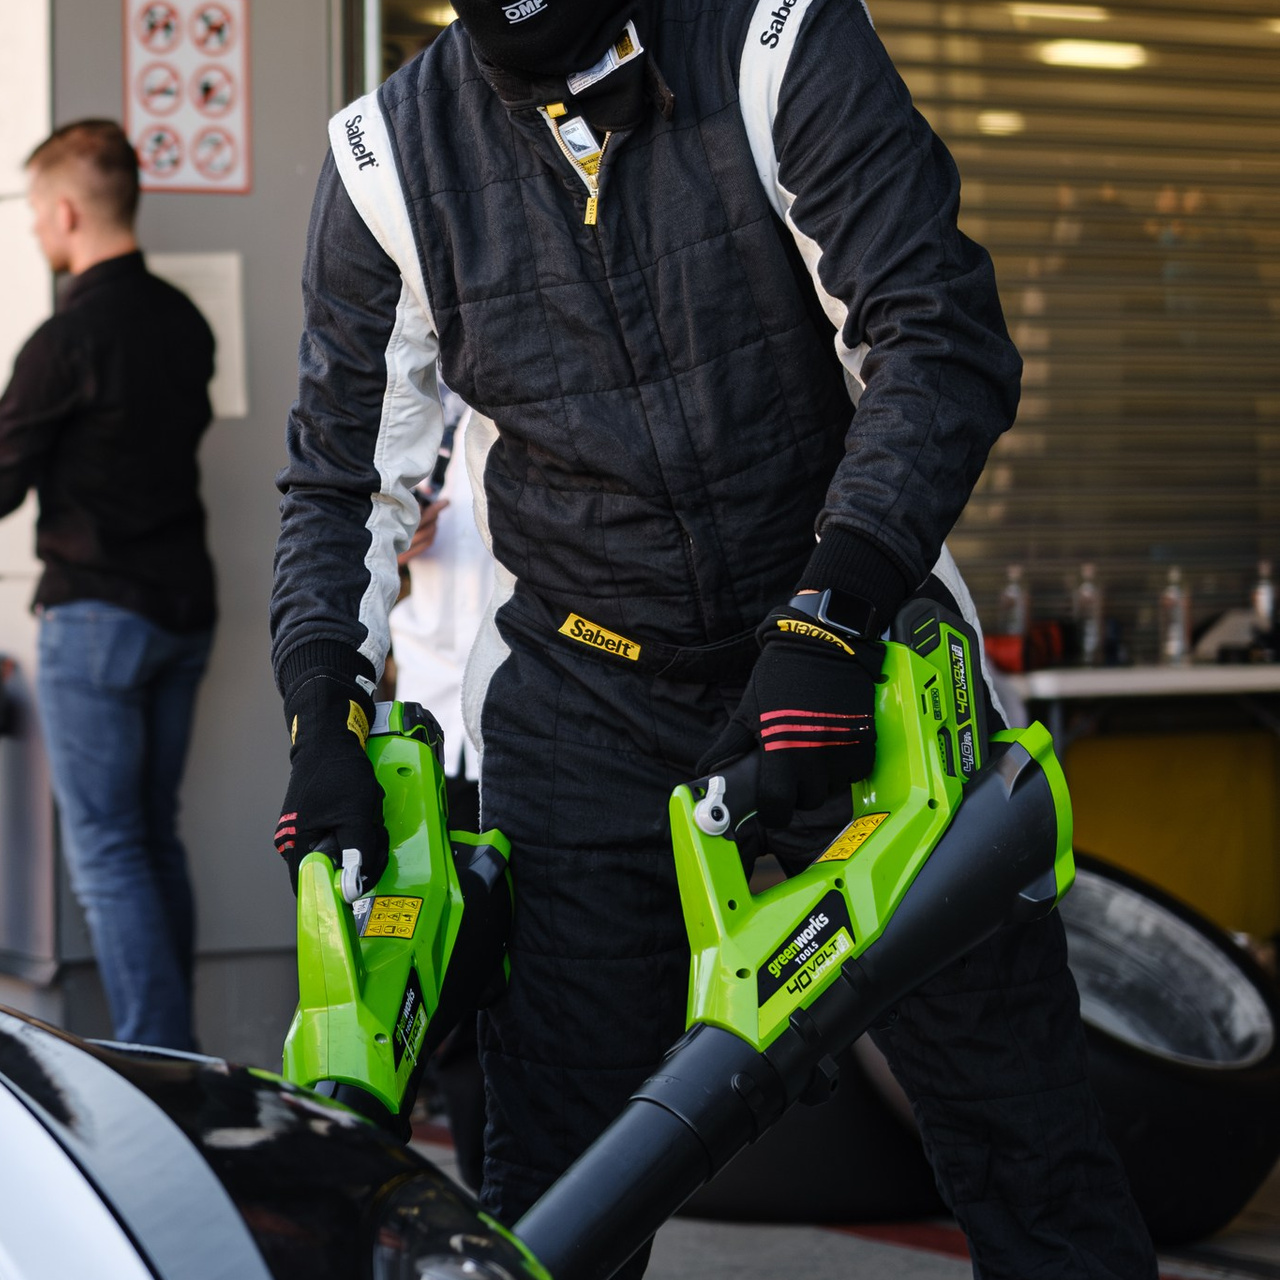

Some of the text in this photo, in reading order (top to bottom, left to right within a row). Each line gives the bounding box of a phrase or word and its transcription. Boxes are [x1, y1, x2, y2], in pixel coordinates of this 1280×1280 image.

[345, 115, 377, 171] Sabelt
[570, 619, 631, 657] Sabelt
[767, 913, 829, 978] greenworks
[794, 941, 819, 965] TOOLS
